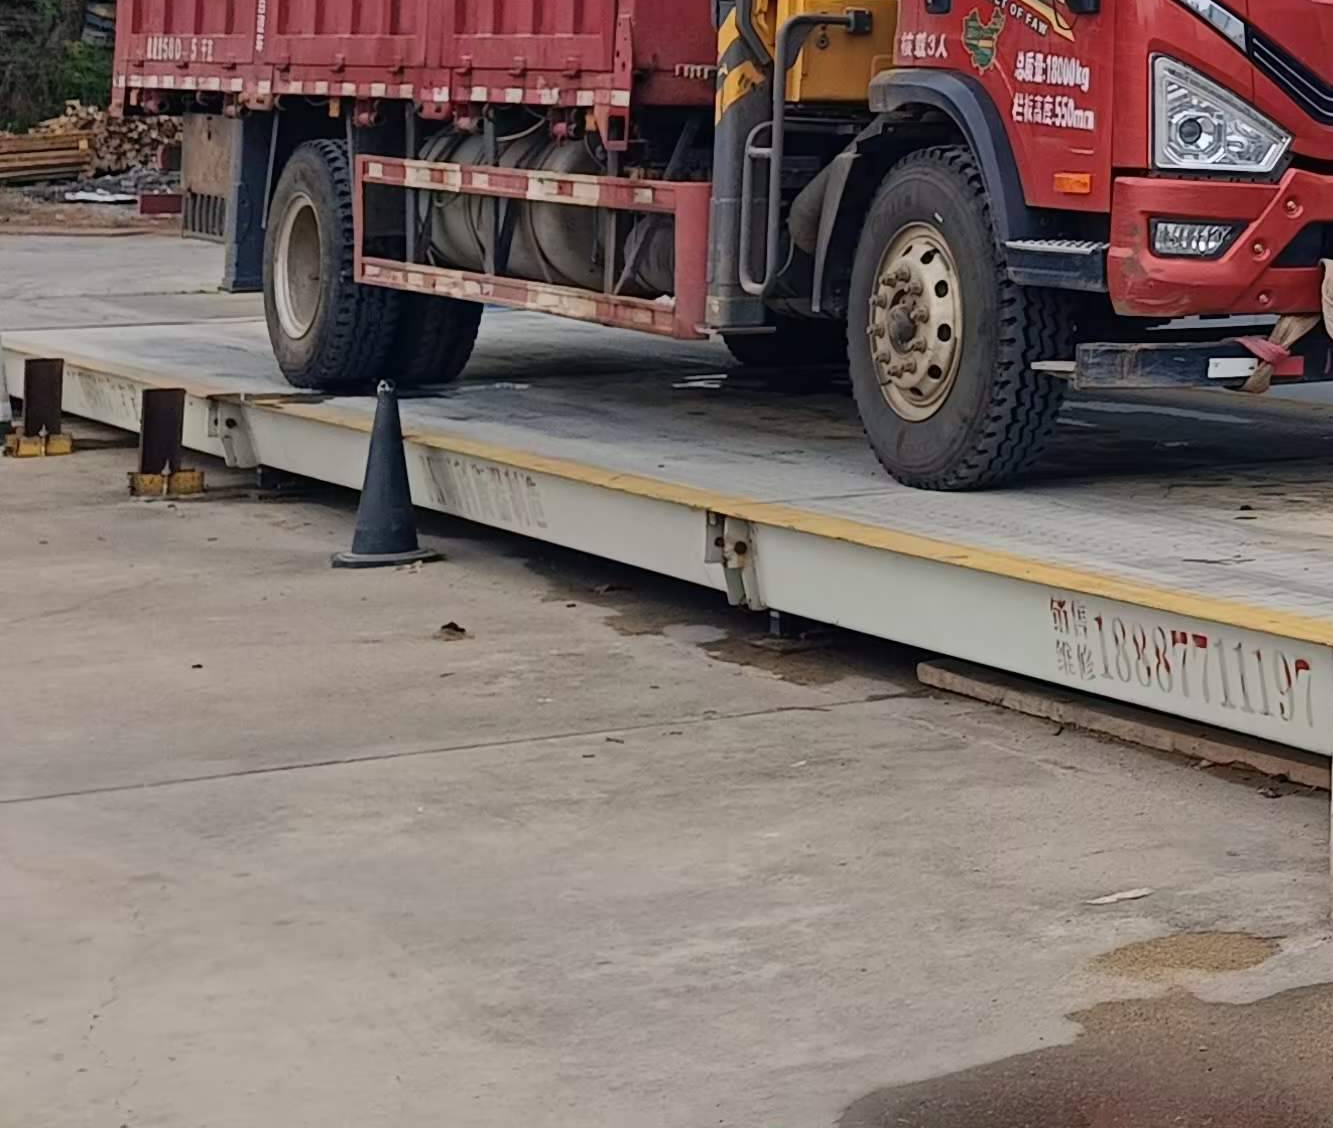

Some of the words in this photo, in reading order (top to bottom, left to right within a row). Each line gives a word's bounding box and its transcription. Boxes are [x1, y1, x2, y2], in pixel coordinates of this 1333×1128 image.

[1010, 3, 1024, 19] OF
[1026, 15, 1048, 35] FAW
[1094, 612, 1314, 728] 18887711197
